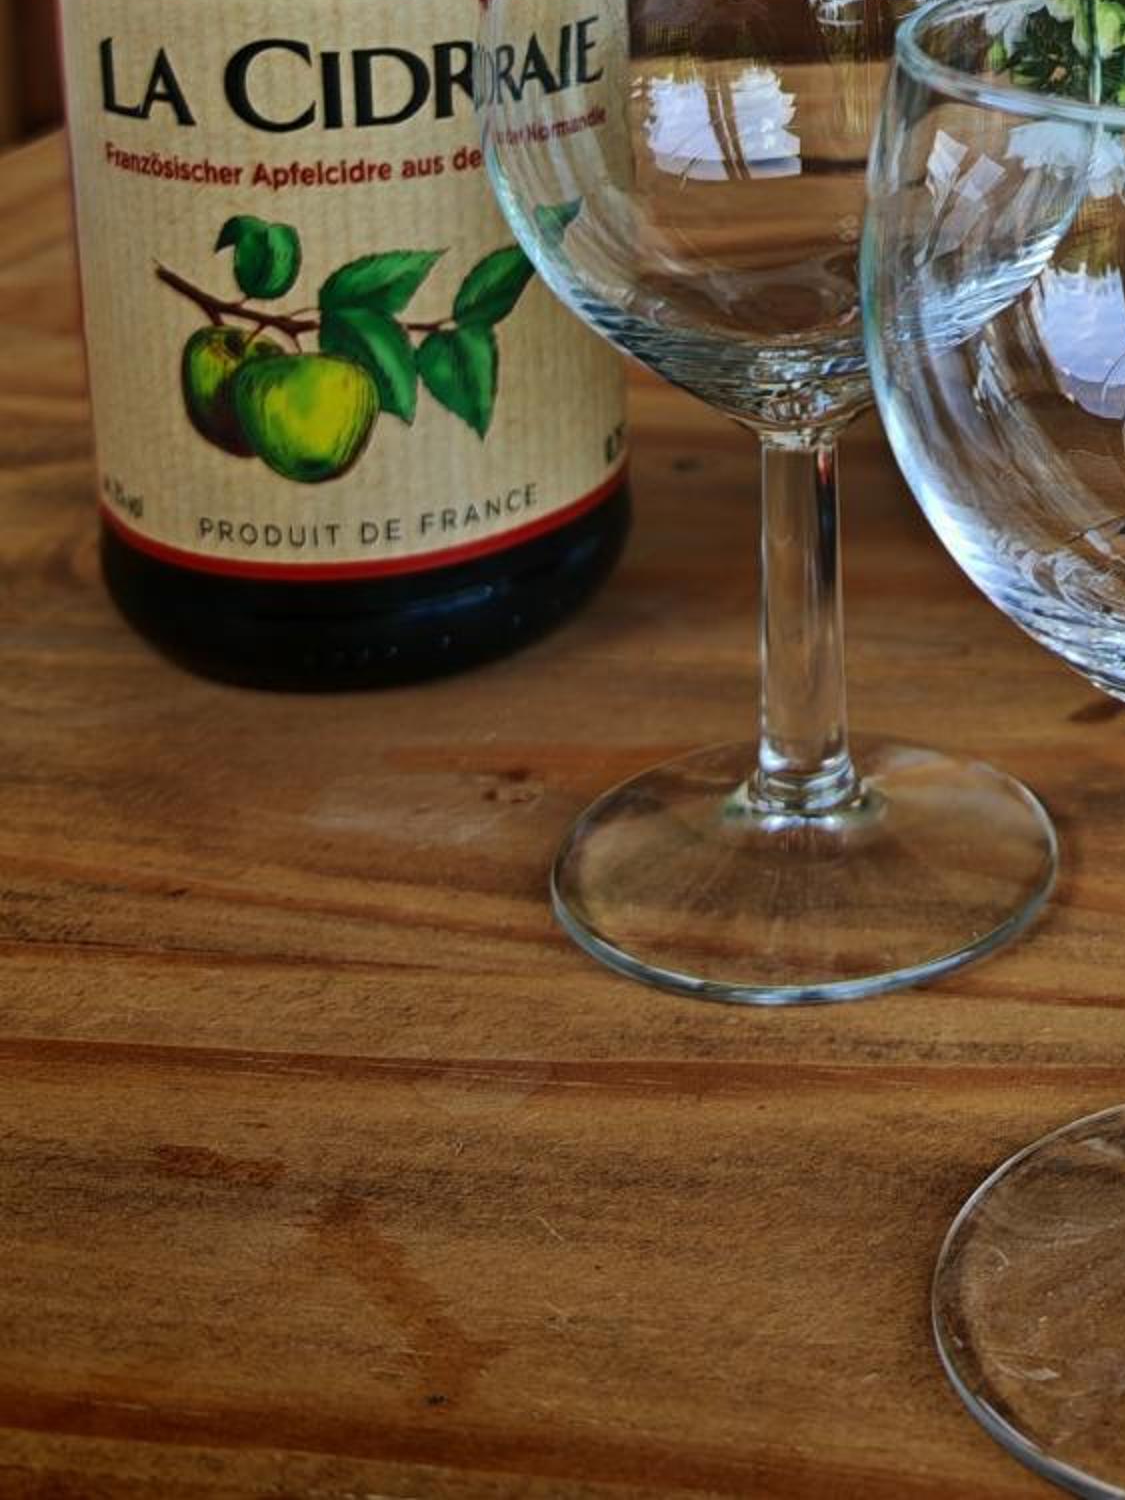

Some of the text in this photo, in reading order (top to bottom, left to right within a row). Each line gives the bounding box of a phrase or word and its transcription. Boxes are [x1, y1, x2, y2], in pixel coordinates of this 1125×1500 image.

[100, 37, 196, 126] LA
[105, 140, 243, 186] Französischer
[252, 160, 392, 191] Apfelcidre
[402, 152, 444, 180] aus
[452, 145, 484, 171] de
[199, 483, 538, 548] PRODUIT DE FRANCE
